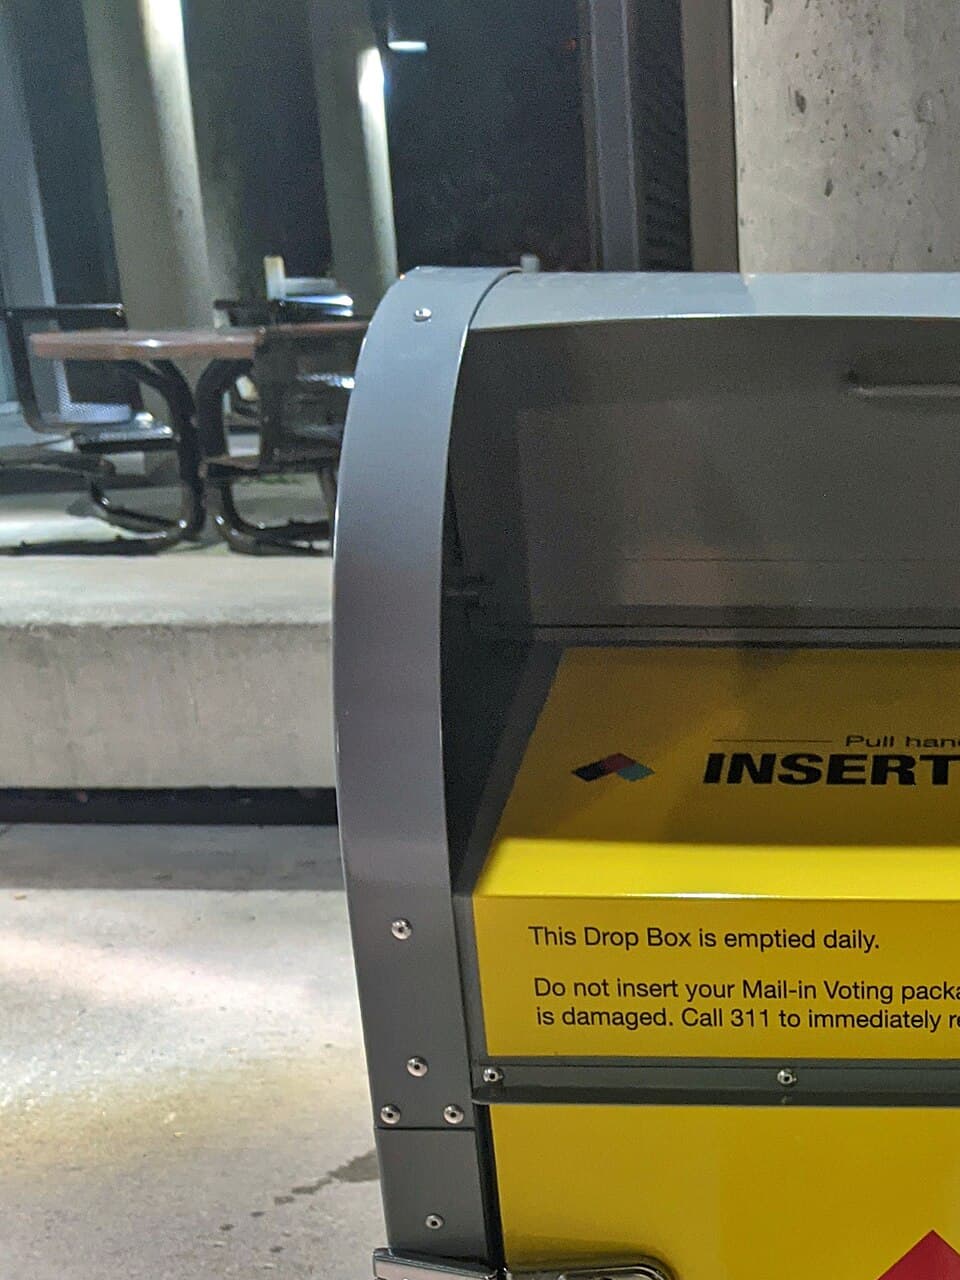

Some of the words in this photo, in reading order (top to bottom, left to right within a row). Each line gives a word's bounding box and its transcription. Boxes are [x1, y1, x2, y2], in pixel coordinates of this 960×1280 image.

[845, 734, 895, 749] Pull
[527, 925, 577, 946] This
[583, 926, 640, 952] Drop
[646, 926, 692, 948] Box
[698, 927, 717, 948] is
[723, 928, 816, 953] emptied
[823, 929, 880, 953] daily.
[534, 977, 566, 997] Do
[573, 978, 610, 997] not
[616, 977, 679, 998] insert
[684, 983, 736, 1003] your
[742, 979, 817, 1000] Mail-in
[823, 980, 894, 1005] Voting
[536, 1006, 555, 1026] is
[561, 1006, 674, 1031] damaged.
[681, 1006, 723, 1028] Call
[730, 1007, 769, 1028] 311
[778, 1009, 801, 1028] to
[808, 1008, 942, 1032] immediately
